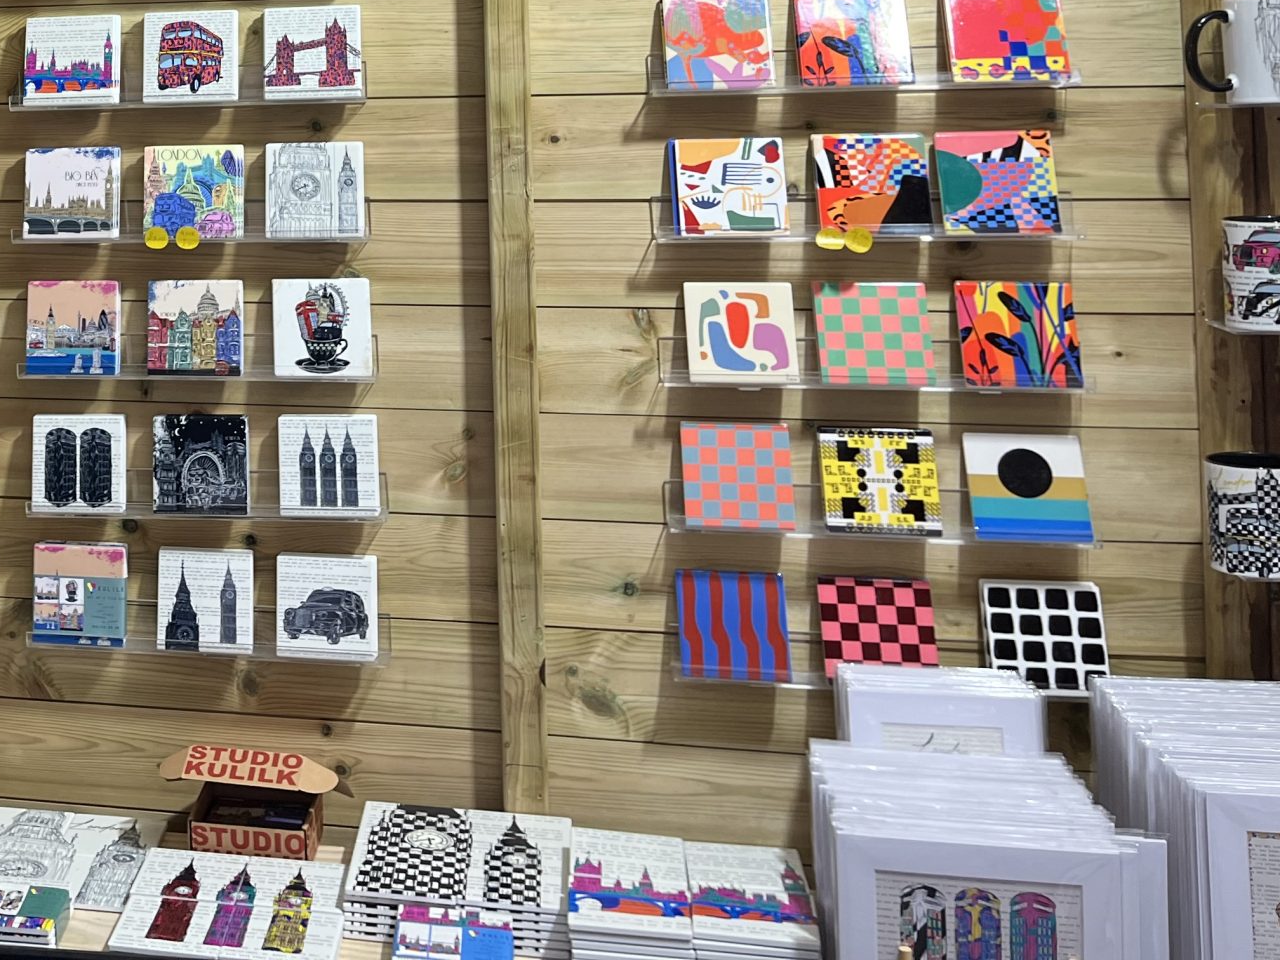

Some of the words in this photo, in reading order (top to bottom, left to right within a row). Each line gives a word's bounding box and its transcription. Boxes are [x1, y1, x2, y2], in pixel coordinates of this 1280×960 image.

[157, 148, 203, 161] LONDON
[189, 744, 304, 769] STUDIO
[183, 760, 299, 786] KULILK
[192, 824, 306, 855] STUDIO
